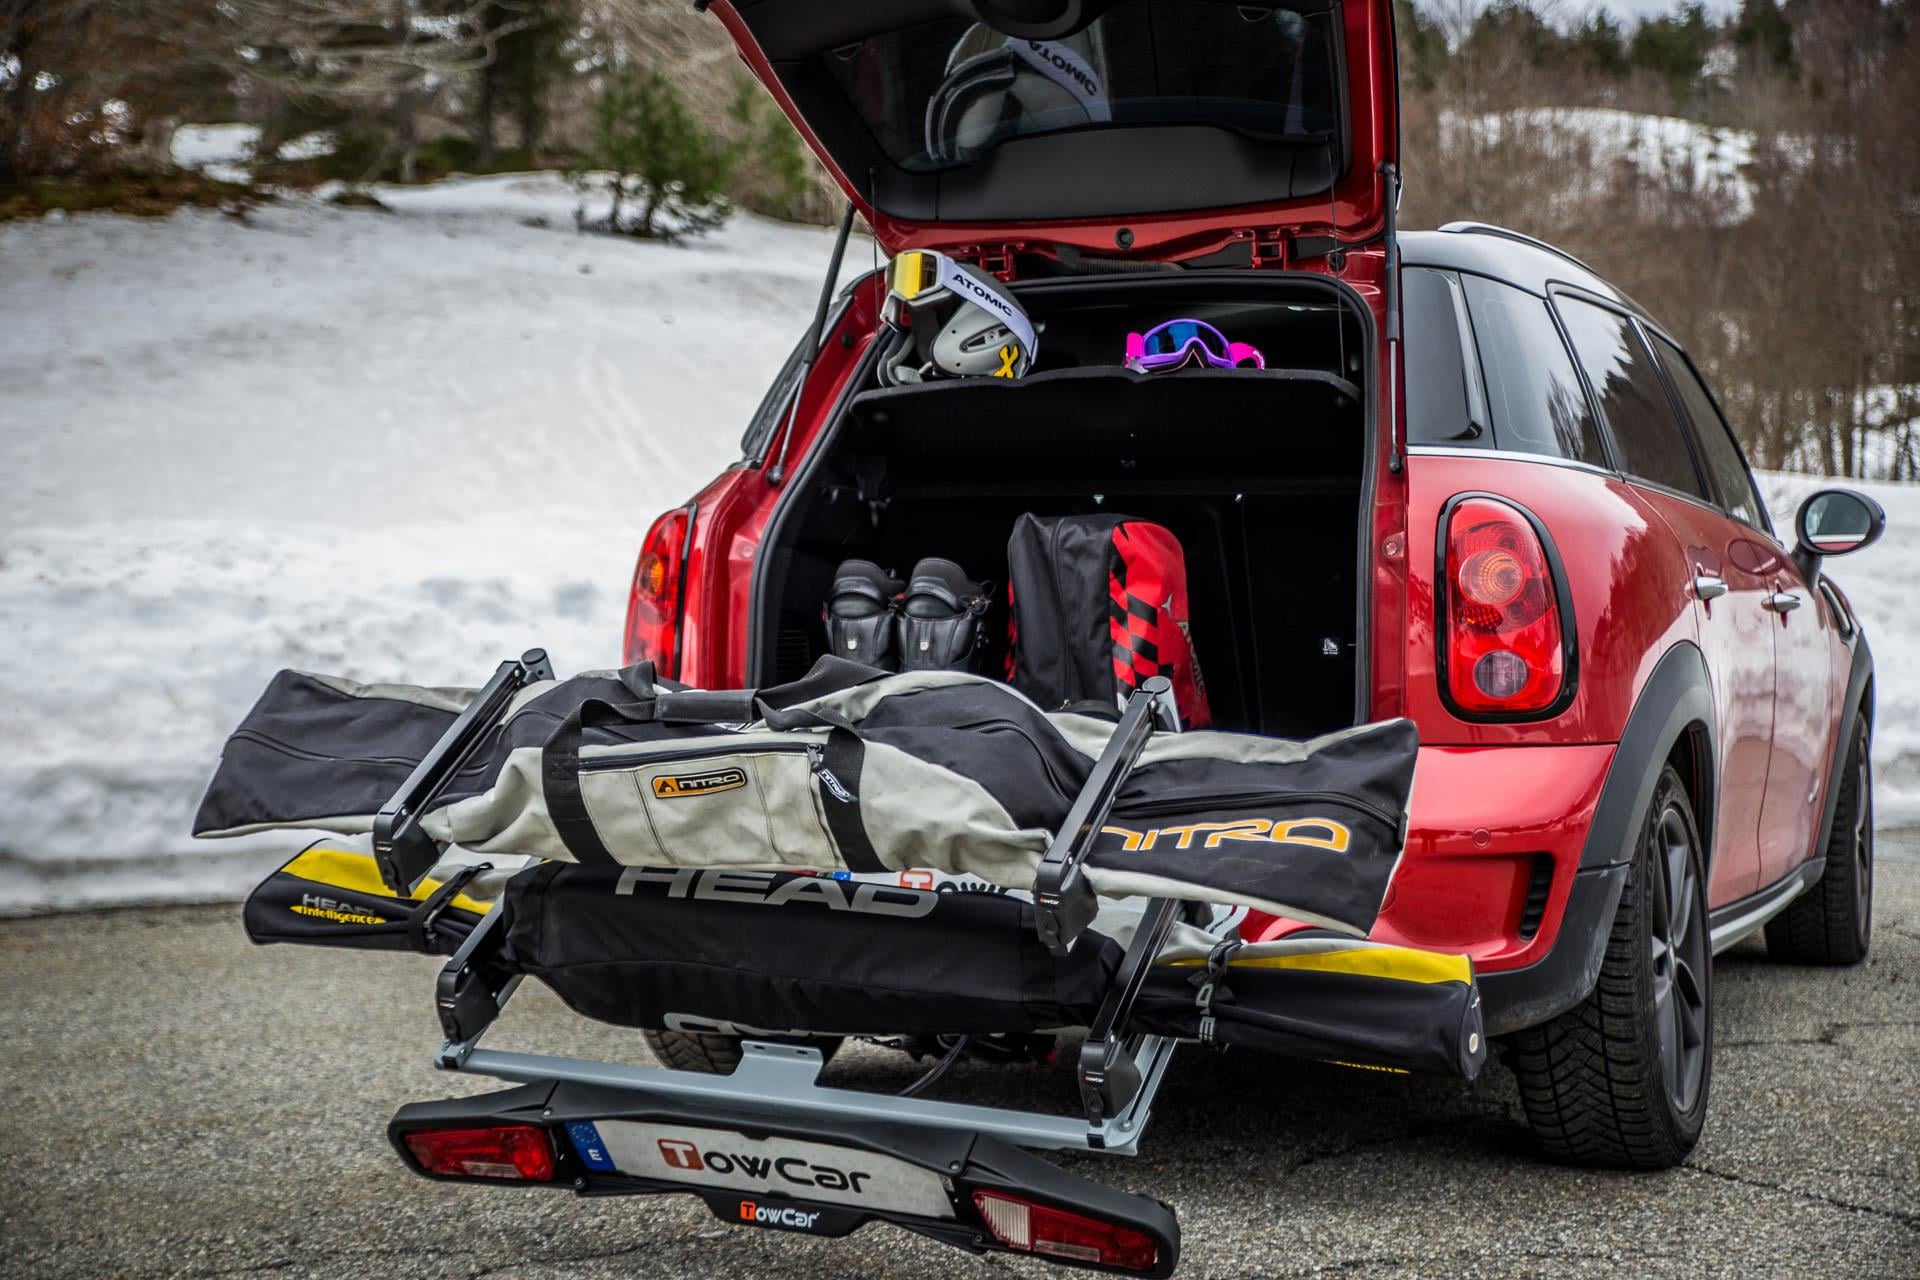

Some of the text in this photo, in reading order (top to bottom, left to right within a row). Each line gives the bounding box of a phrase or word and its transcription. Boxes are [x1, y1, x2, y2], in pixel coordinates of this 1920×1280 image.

[952, 273, 1013, 317] ATOMIC
[614, 866, 938, 918] HEAD
[588, 1148, 603, 1162] E
[657, 1138, 871, 1194] TowCar
[740, 1200, 820, 1228] TowCar
